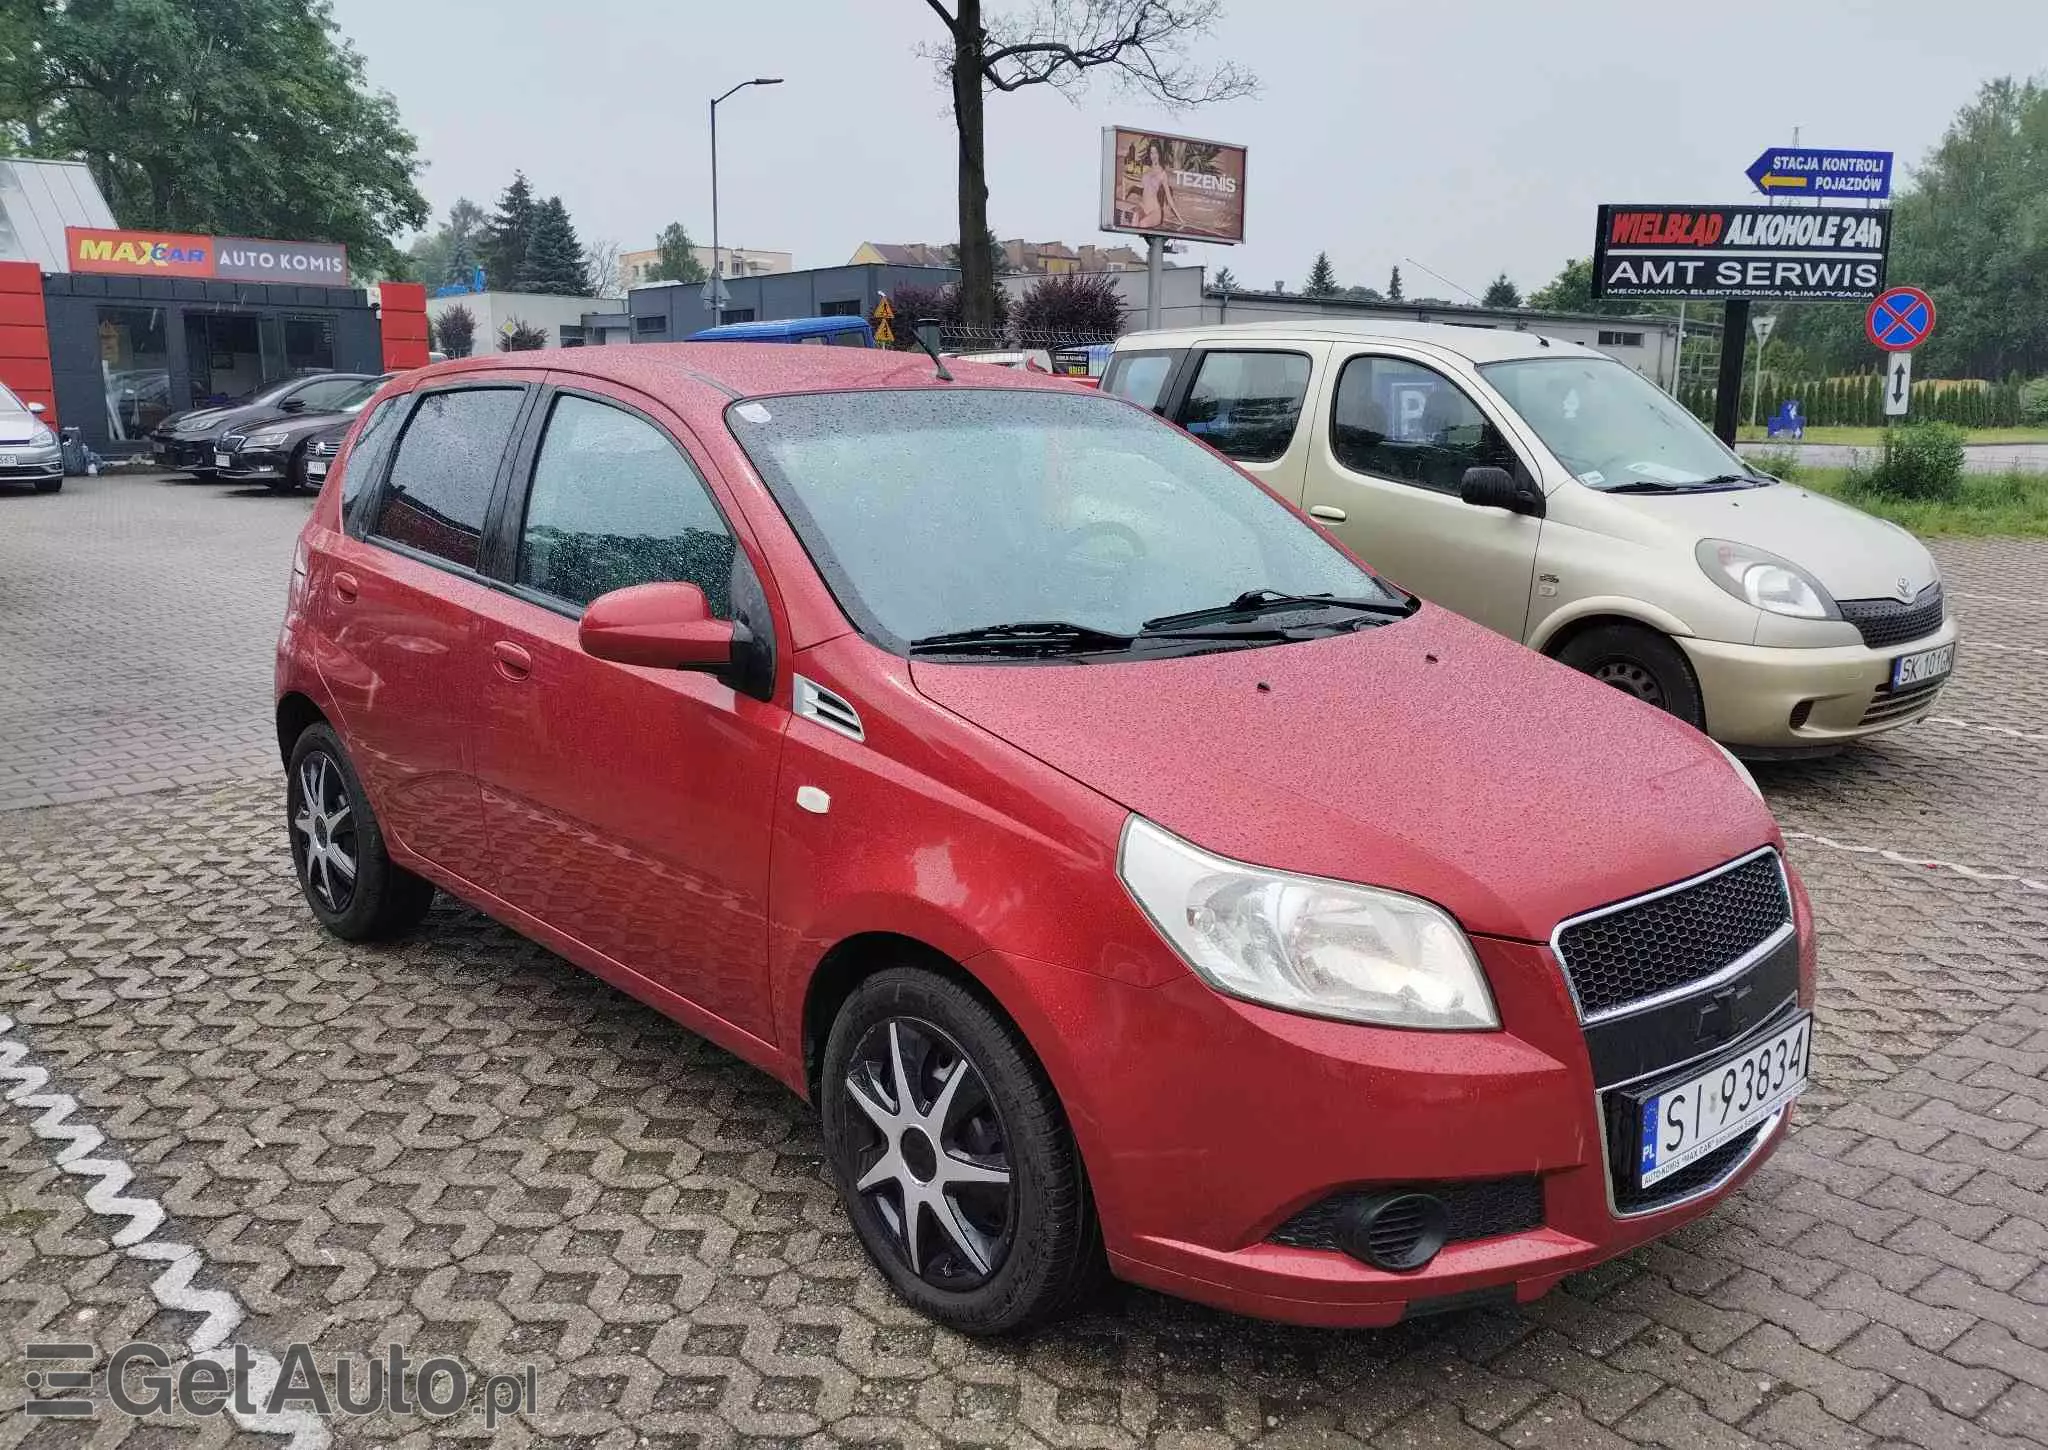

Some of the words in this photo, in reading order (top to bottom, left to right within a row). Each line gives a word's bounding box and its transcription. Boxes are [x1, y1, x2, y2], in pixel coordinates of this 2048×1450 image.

[1773, 155, 1819, 171] STACJA
[1822, 158, 1884, 173] KONTROLI
[1173, 169, 1237, 193] TEZENIS
[1815, 174, 1882, 192] POJAZDÓW
[1611, 212, 1723, 247] WIELBŁĄD
[1723, 213, 1840, 247] ALKOHOLE
[1840, 217, 1883, 249] 24h
[219, 249, 275, 269] AUTO
[280, 254, 343, 274] KOMIS
[1608, 260, 1705, 285] AMT
[1715, 262, 1878, 288] SERWIS
[1606, 287, 1688, 296] MECHANIKA
[1689, 288, 1782, 297] ELEKTRONIKA
[1783, 290, 1875, 298] KLIMATYZACJA
[1666, 1085, 1702, 1152] SI
[1719, 1026, 1804, 1126] 93834
[1642, 1143, 1655, 1162] PL
